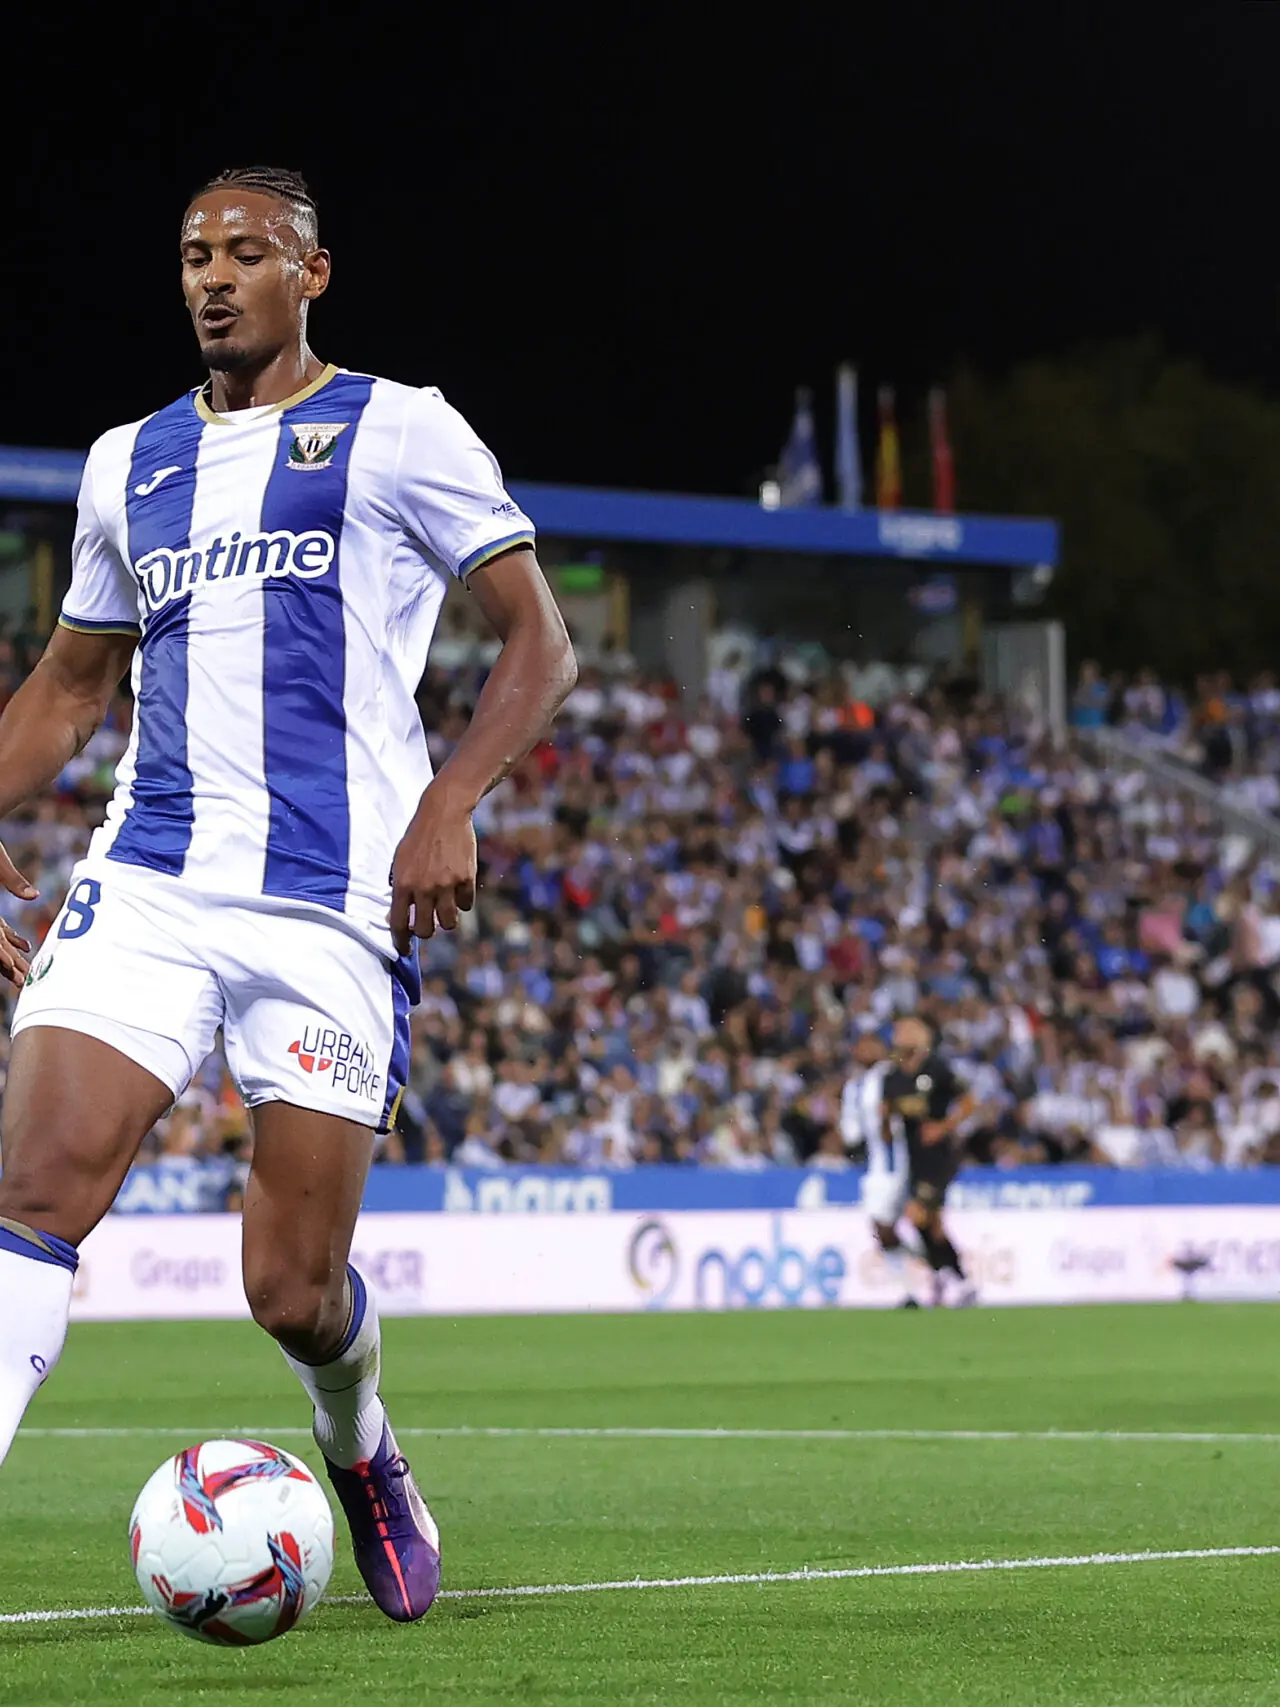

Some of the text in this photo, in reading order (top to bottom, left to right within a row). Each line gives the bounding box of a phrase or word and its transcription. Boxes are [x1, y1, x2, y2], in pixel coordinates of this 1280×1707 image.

[138, 531, 330, 605] Ontime
[57, 878, 101, 939] 8
[302, 1026, 375, 1071] URBAN
[332, 1061, 380, 1102] POKE
